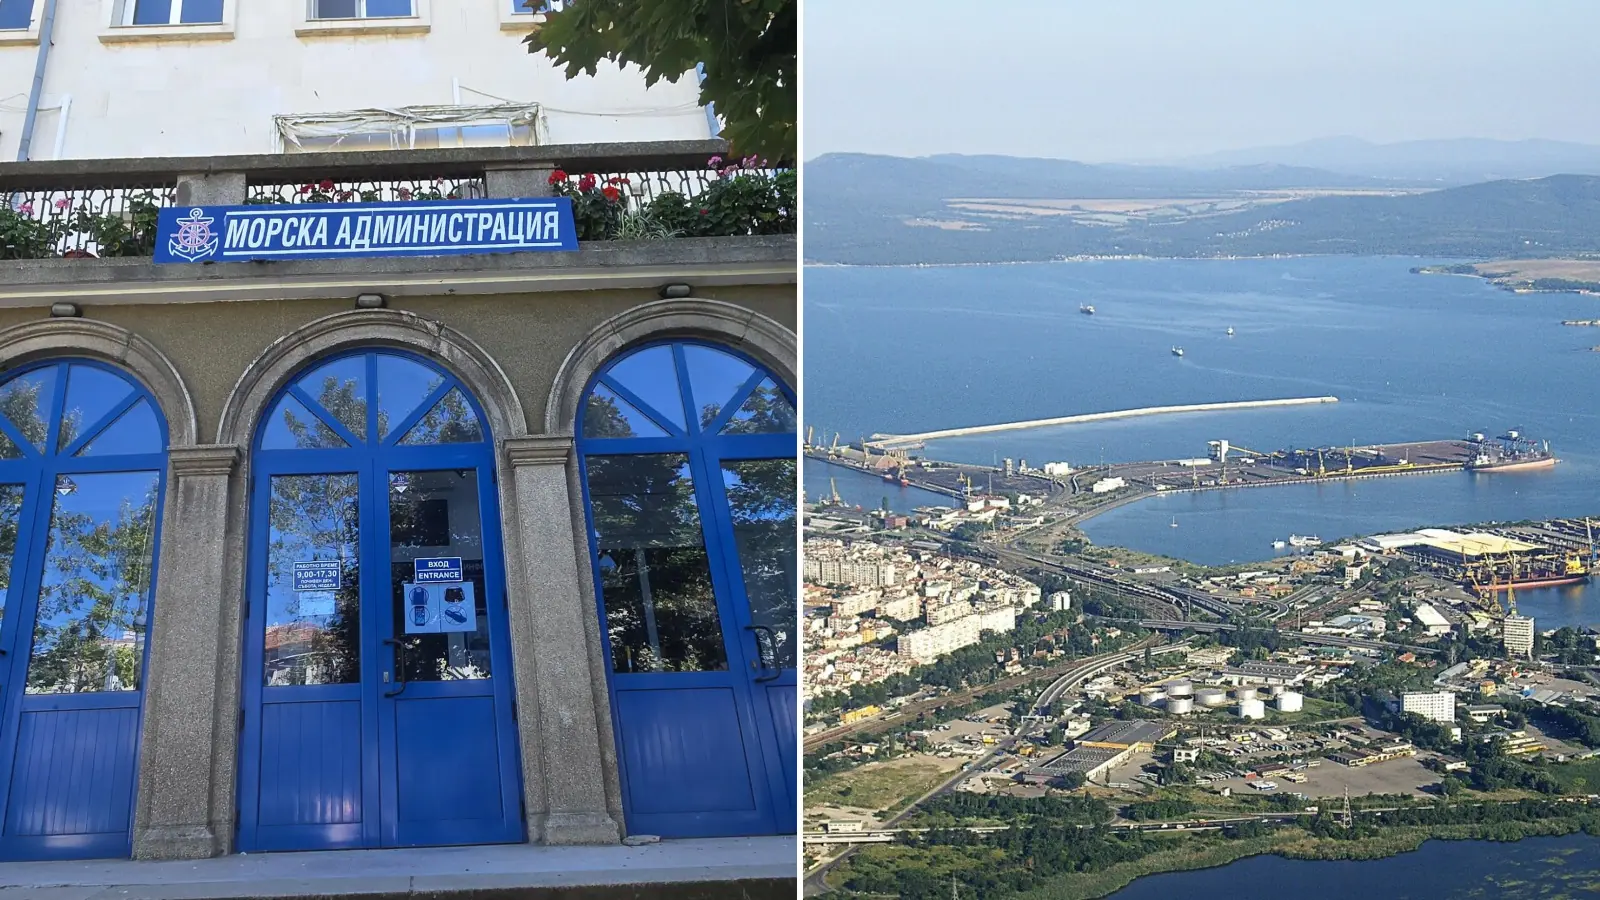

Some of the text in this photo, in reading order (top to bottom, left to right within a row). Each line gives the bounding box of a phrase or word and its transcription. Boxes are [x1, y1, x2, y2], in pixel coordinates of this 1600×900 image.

[224, 211, 560, 249] МОРСКА АДМИНИСТРАЦИЯ
[428, 560, 449, 568] ВХОД
[297, 570, 337, 579] 9,00-17,30
[418, 571, 460, 580] ENTRANCE
